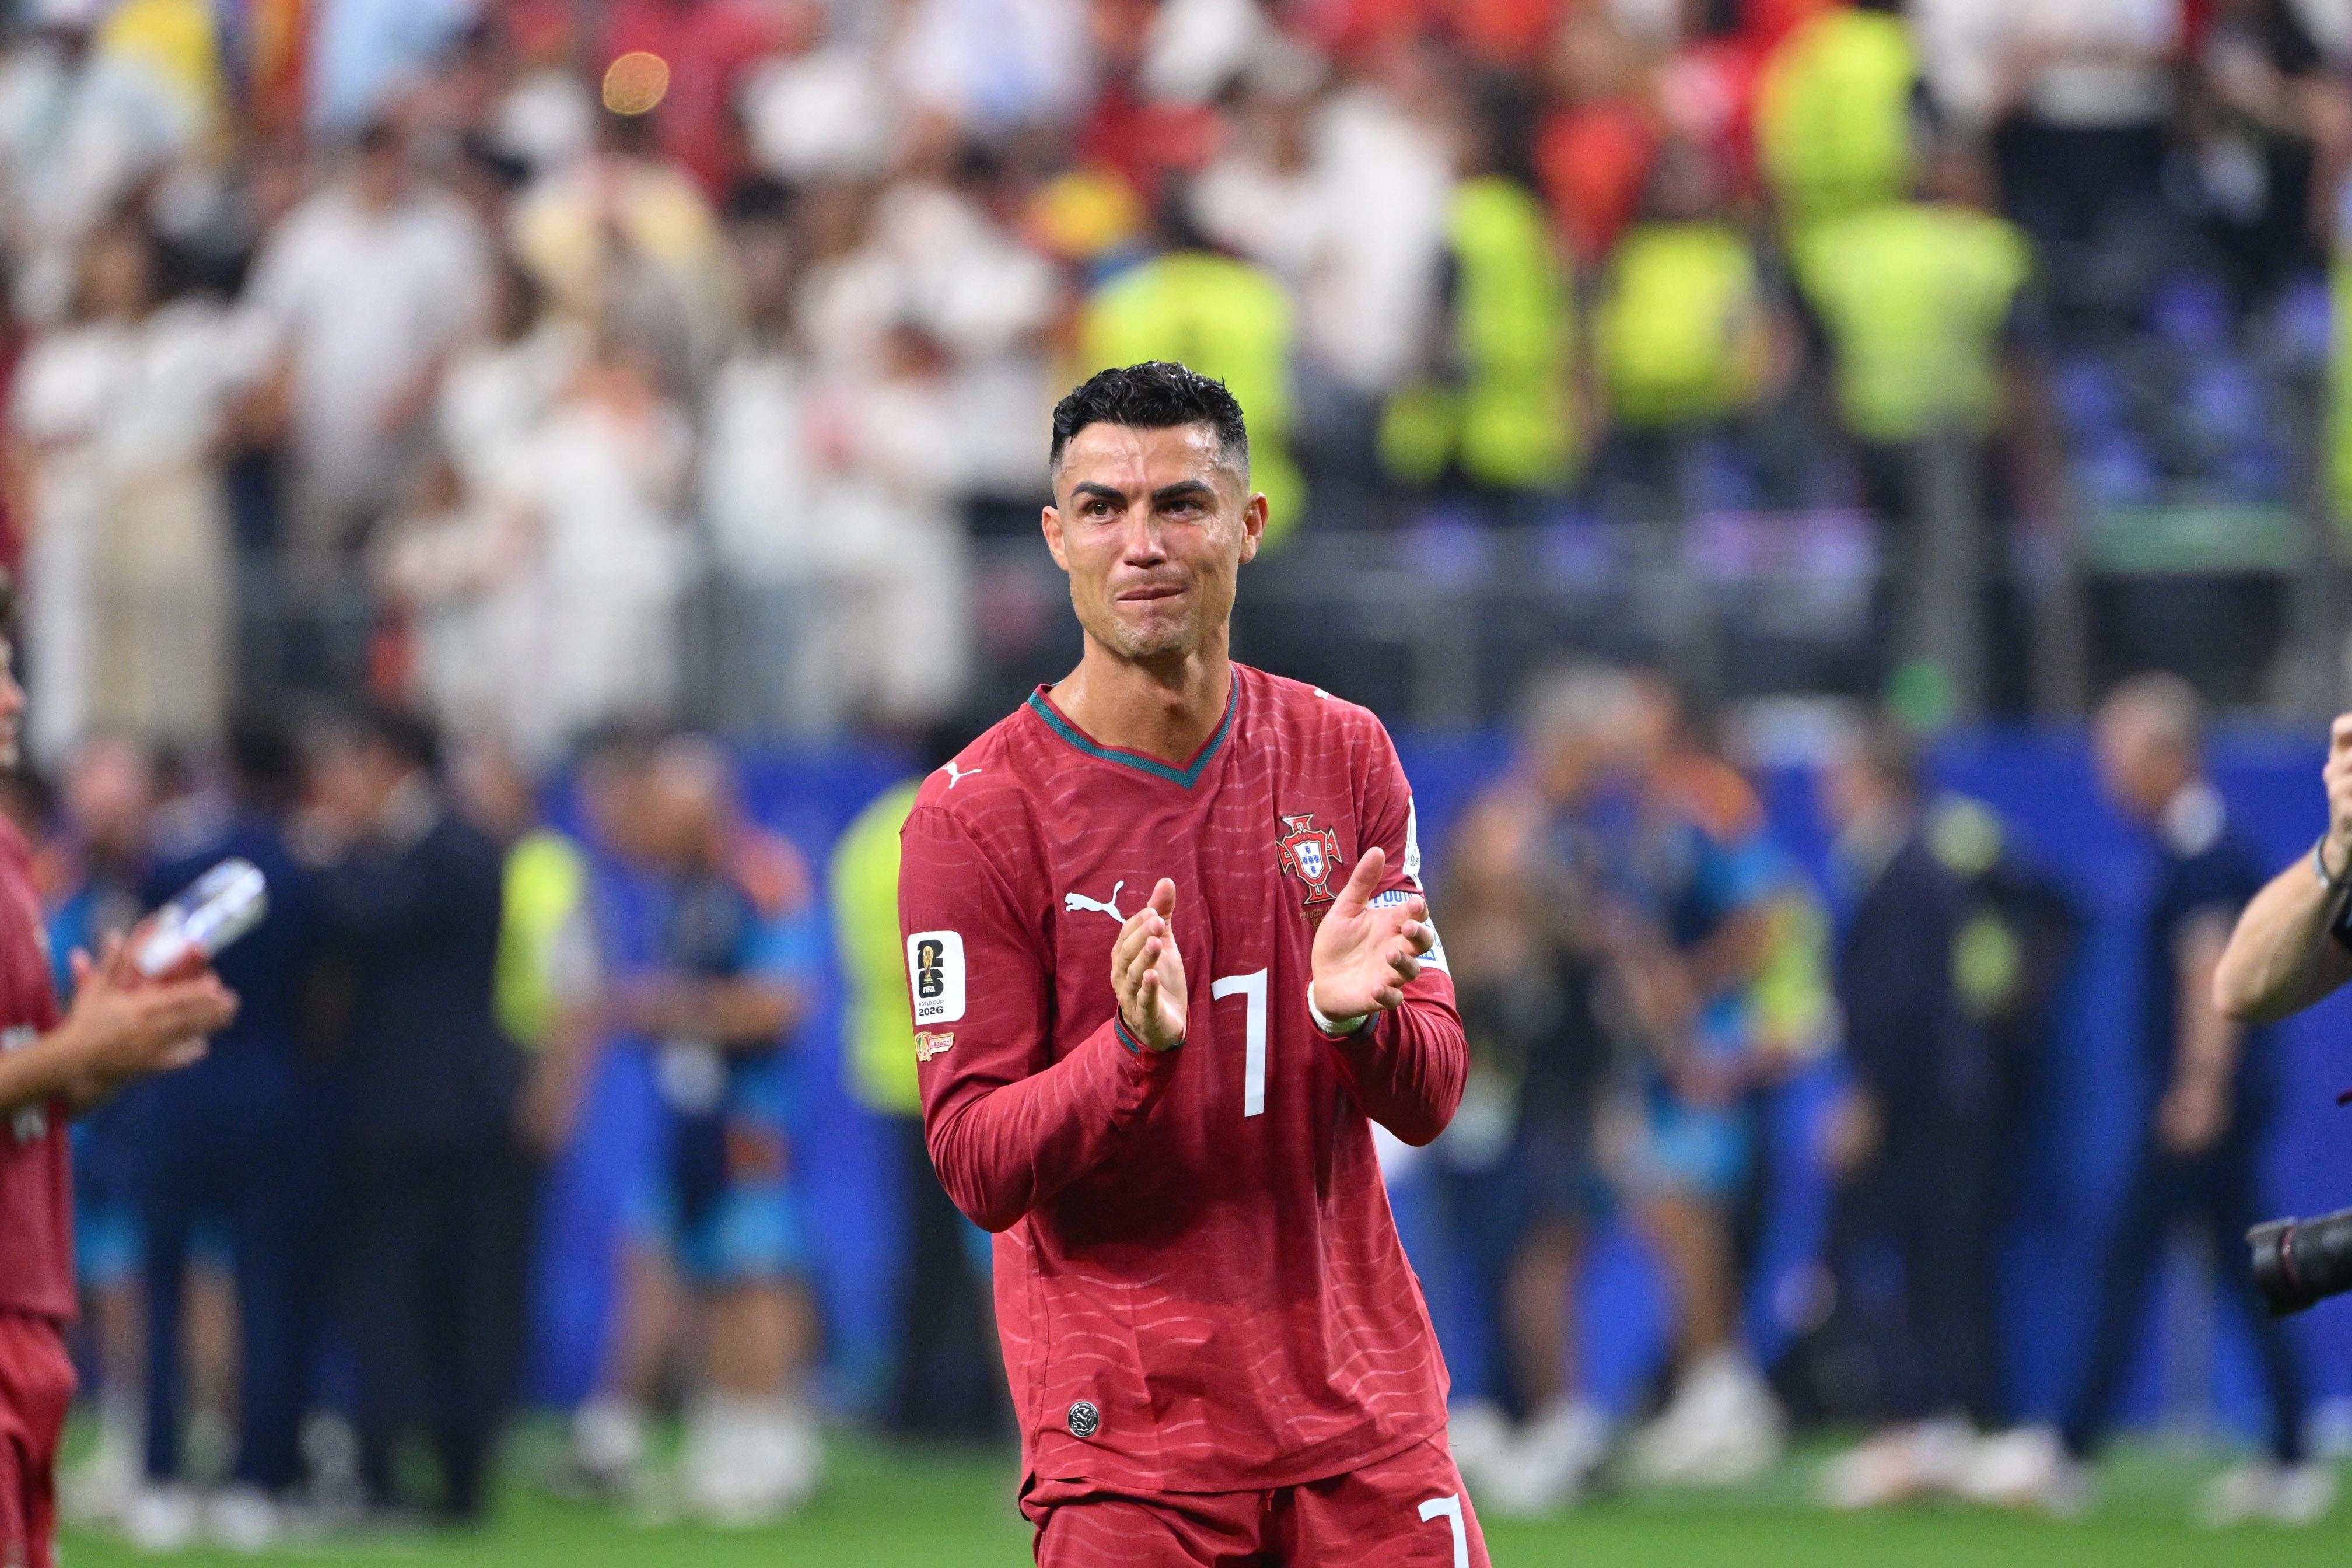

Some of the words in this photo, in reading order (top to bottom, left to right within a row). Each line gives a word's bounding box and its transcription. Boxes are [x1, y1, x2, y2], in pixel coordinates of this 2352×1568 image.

[919, 1006, 944, 1016] 2026
[923, 986, 936, 994] FIFA
[1210, 967, 1268, 1118] 7
[1417, 1492, 1469, 1568] 7
